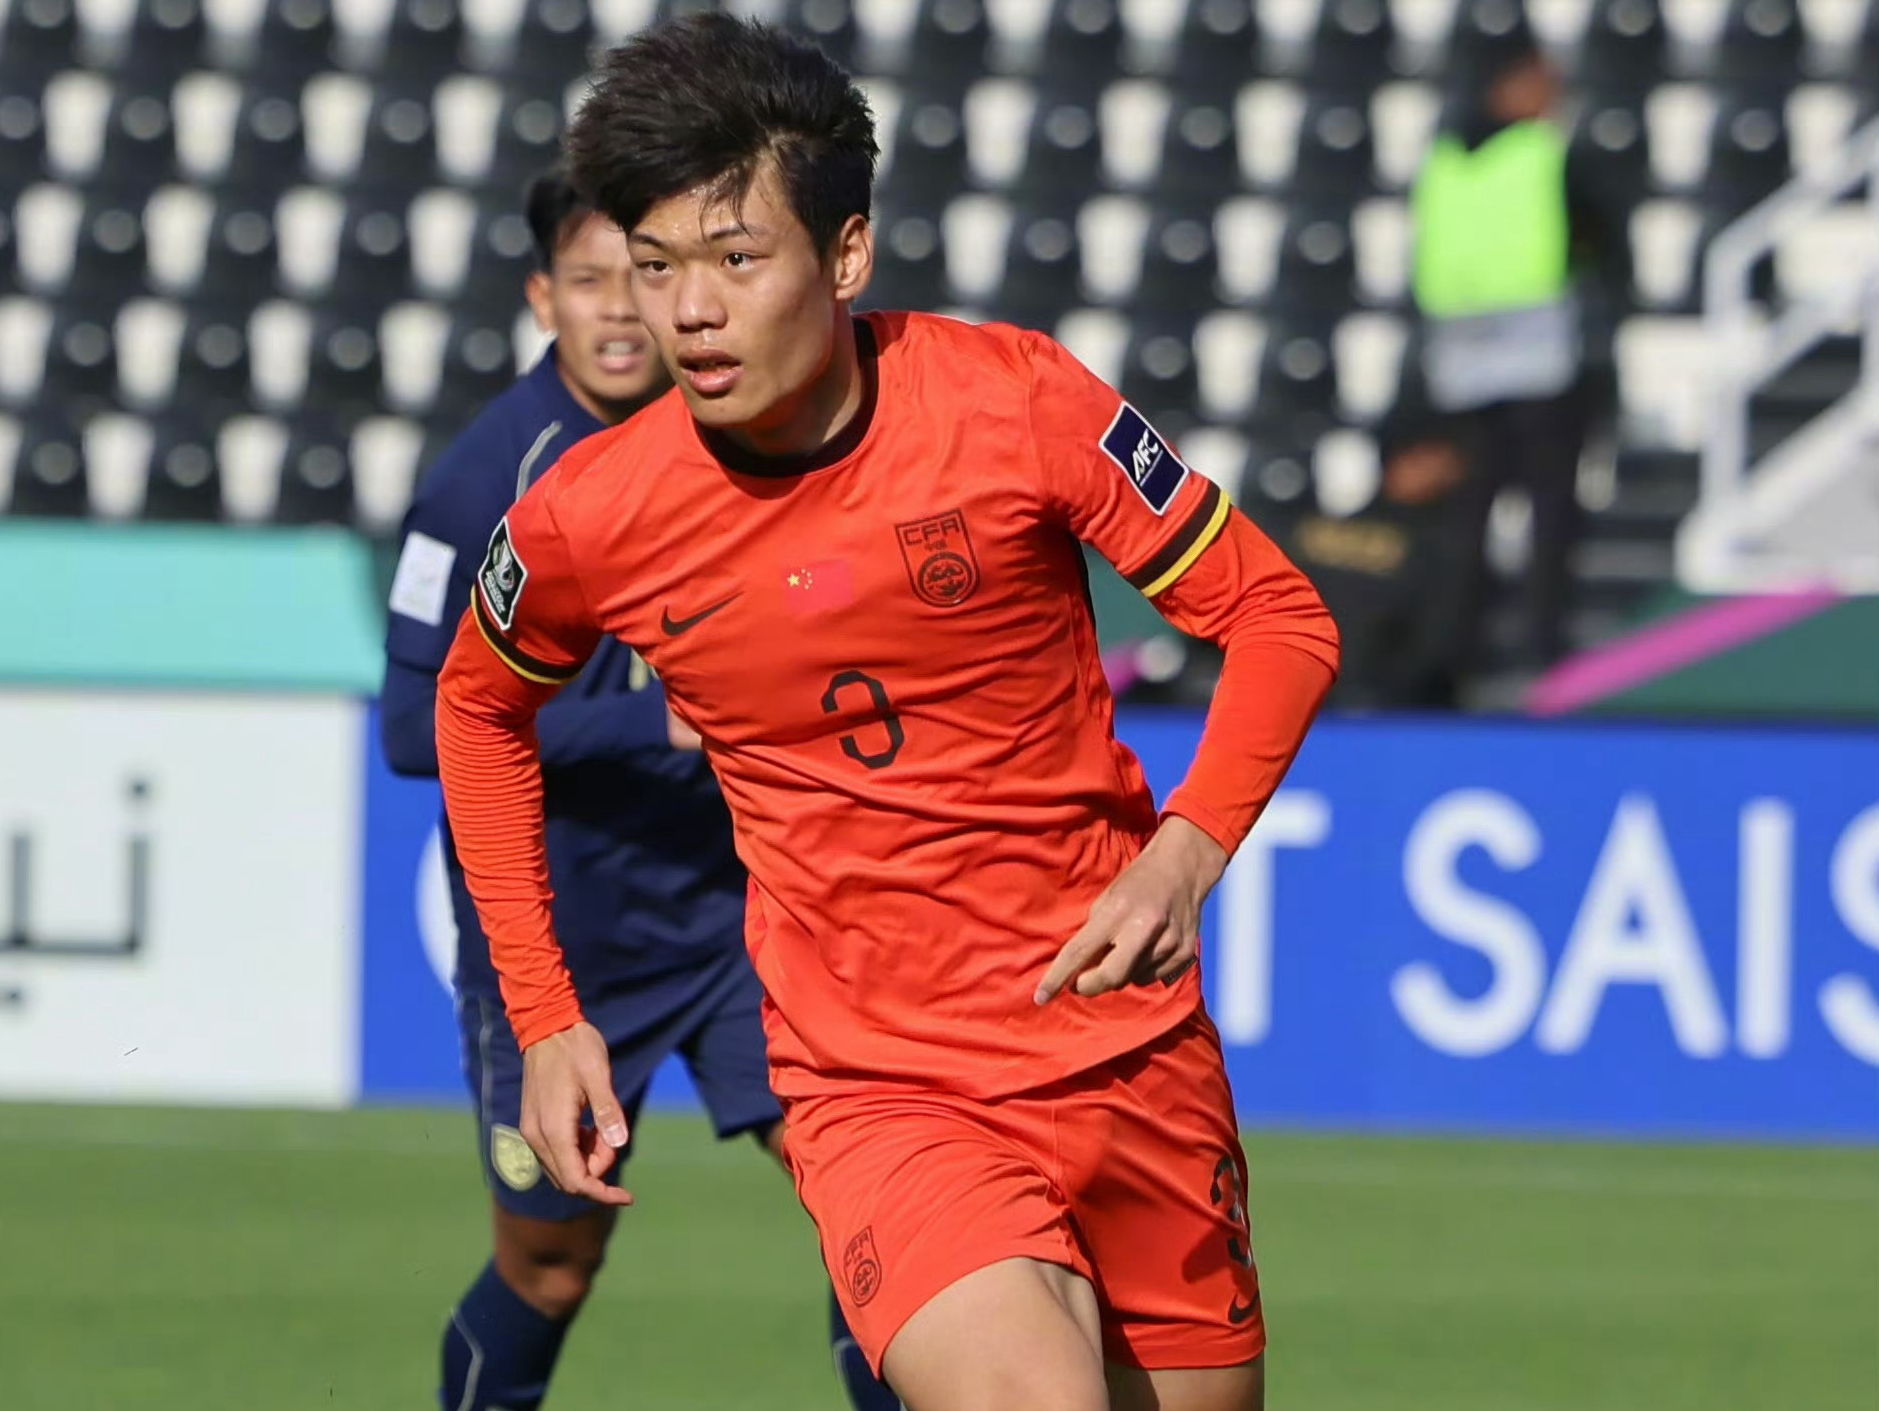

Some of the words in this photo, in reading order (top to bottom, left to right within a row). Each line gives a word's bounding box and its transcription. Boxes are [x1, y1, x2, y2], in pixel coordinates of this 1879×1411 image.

[1132, 427, 1160, 483] AFC
[903, 516, 960, 547] CFA
[820, 670, 905, 770] 3
